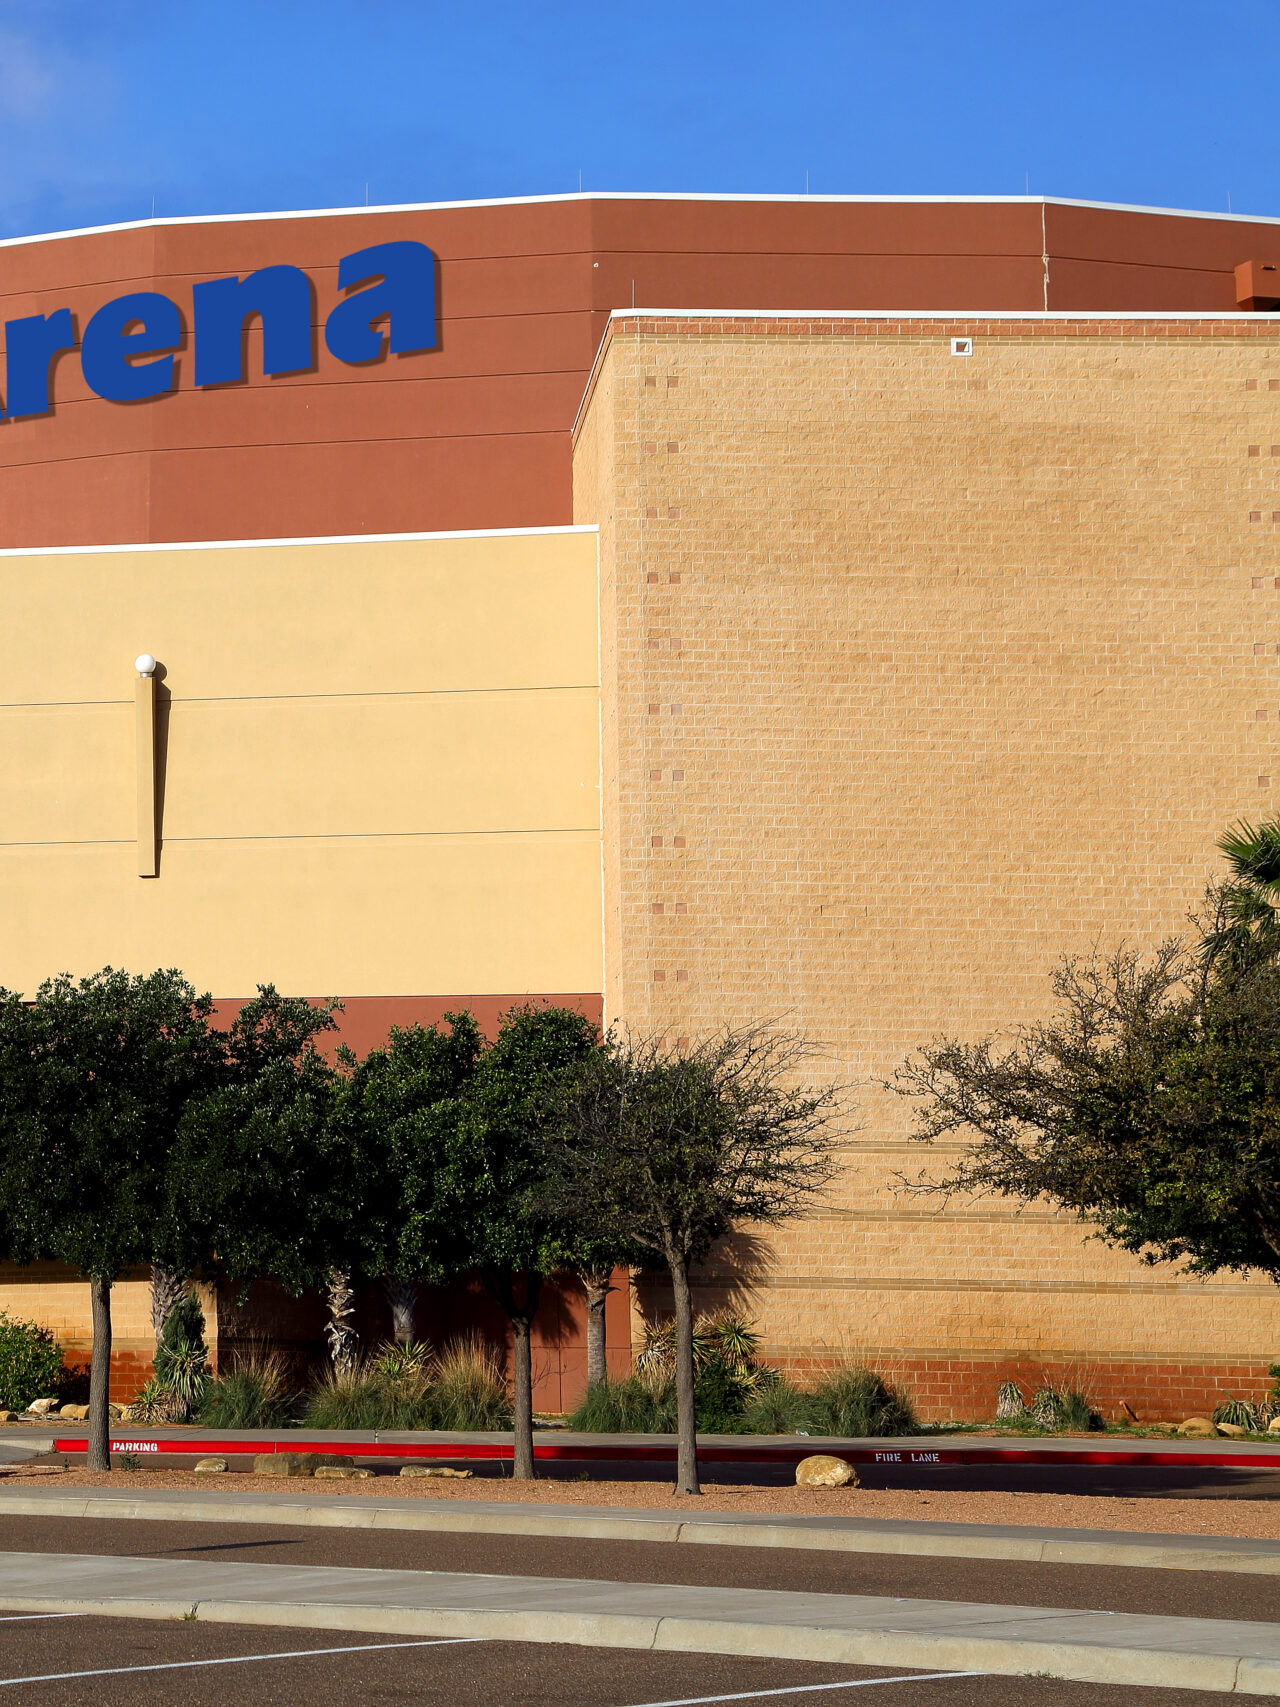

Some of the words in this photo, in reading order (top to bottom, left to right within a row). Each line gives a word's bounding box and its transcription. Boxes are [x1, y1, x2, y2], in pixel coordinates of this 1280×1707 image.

[112, 1442, 158, 1451] PARKING
[875, 1453, 901, 1462] FIRE
[911, 1453, 940, 1462] LANE
